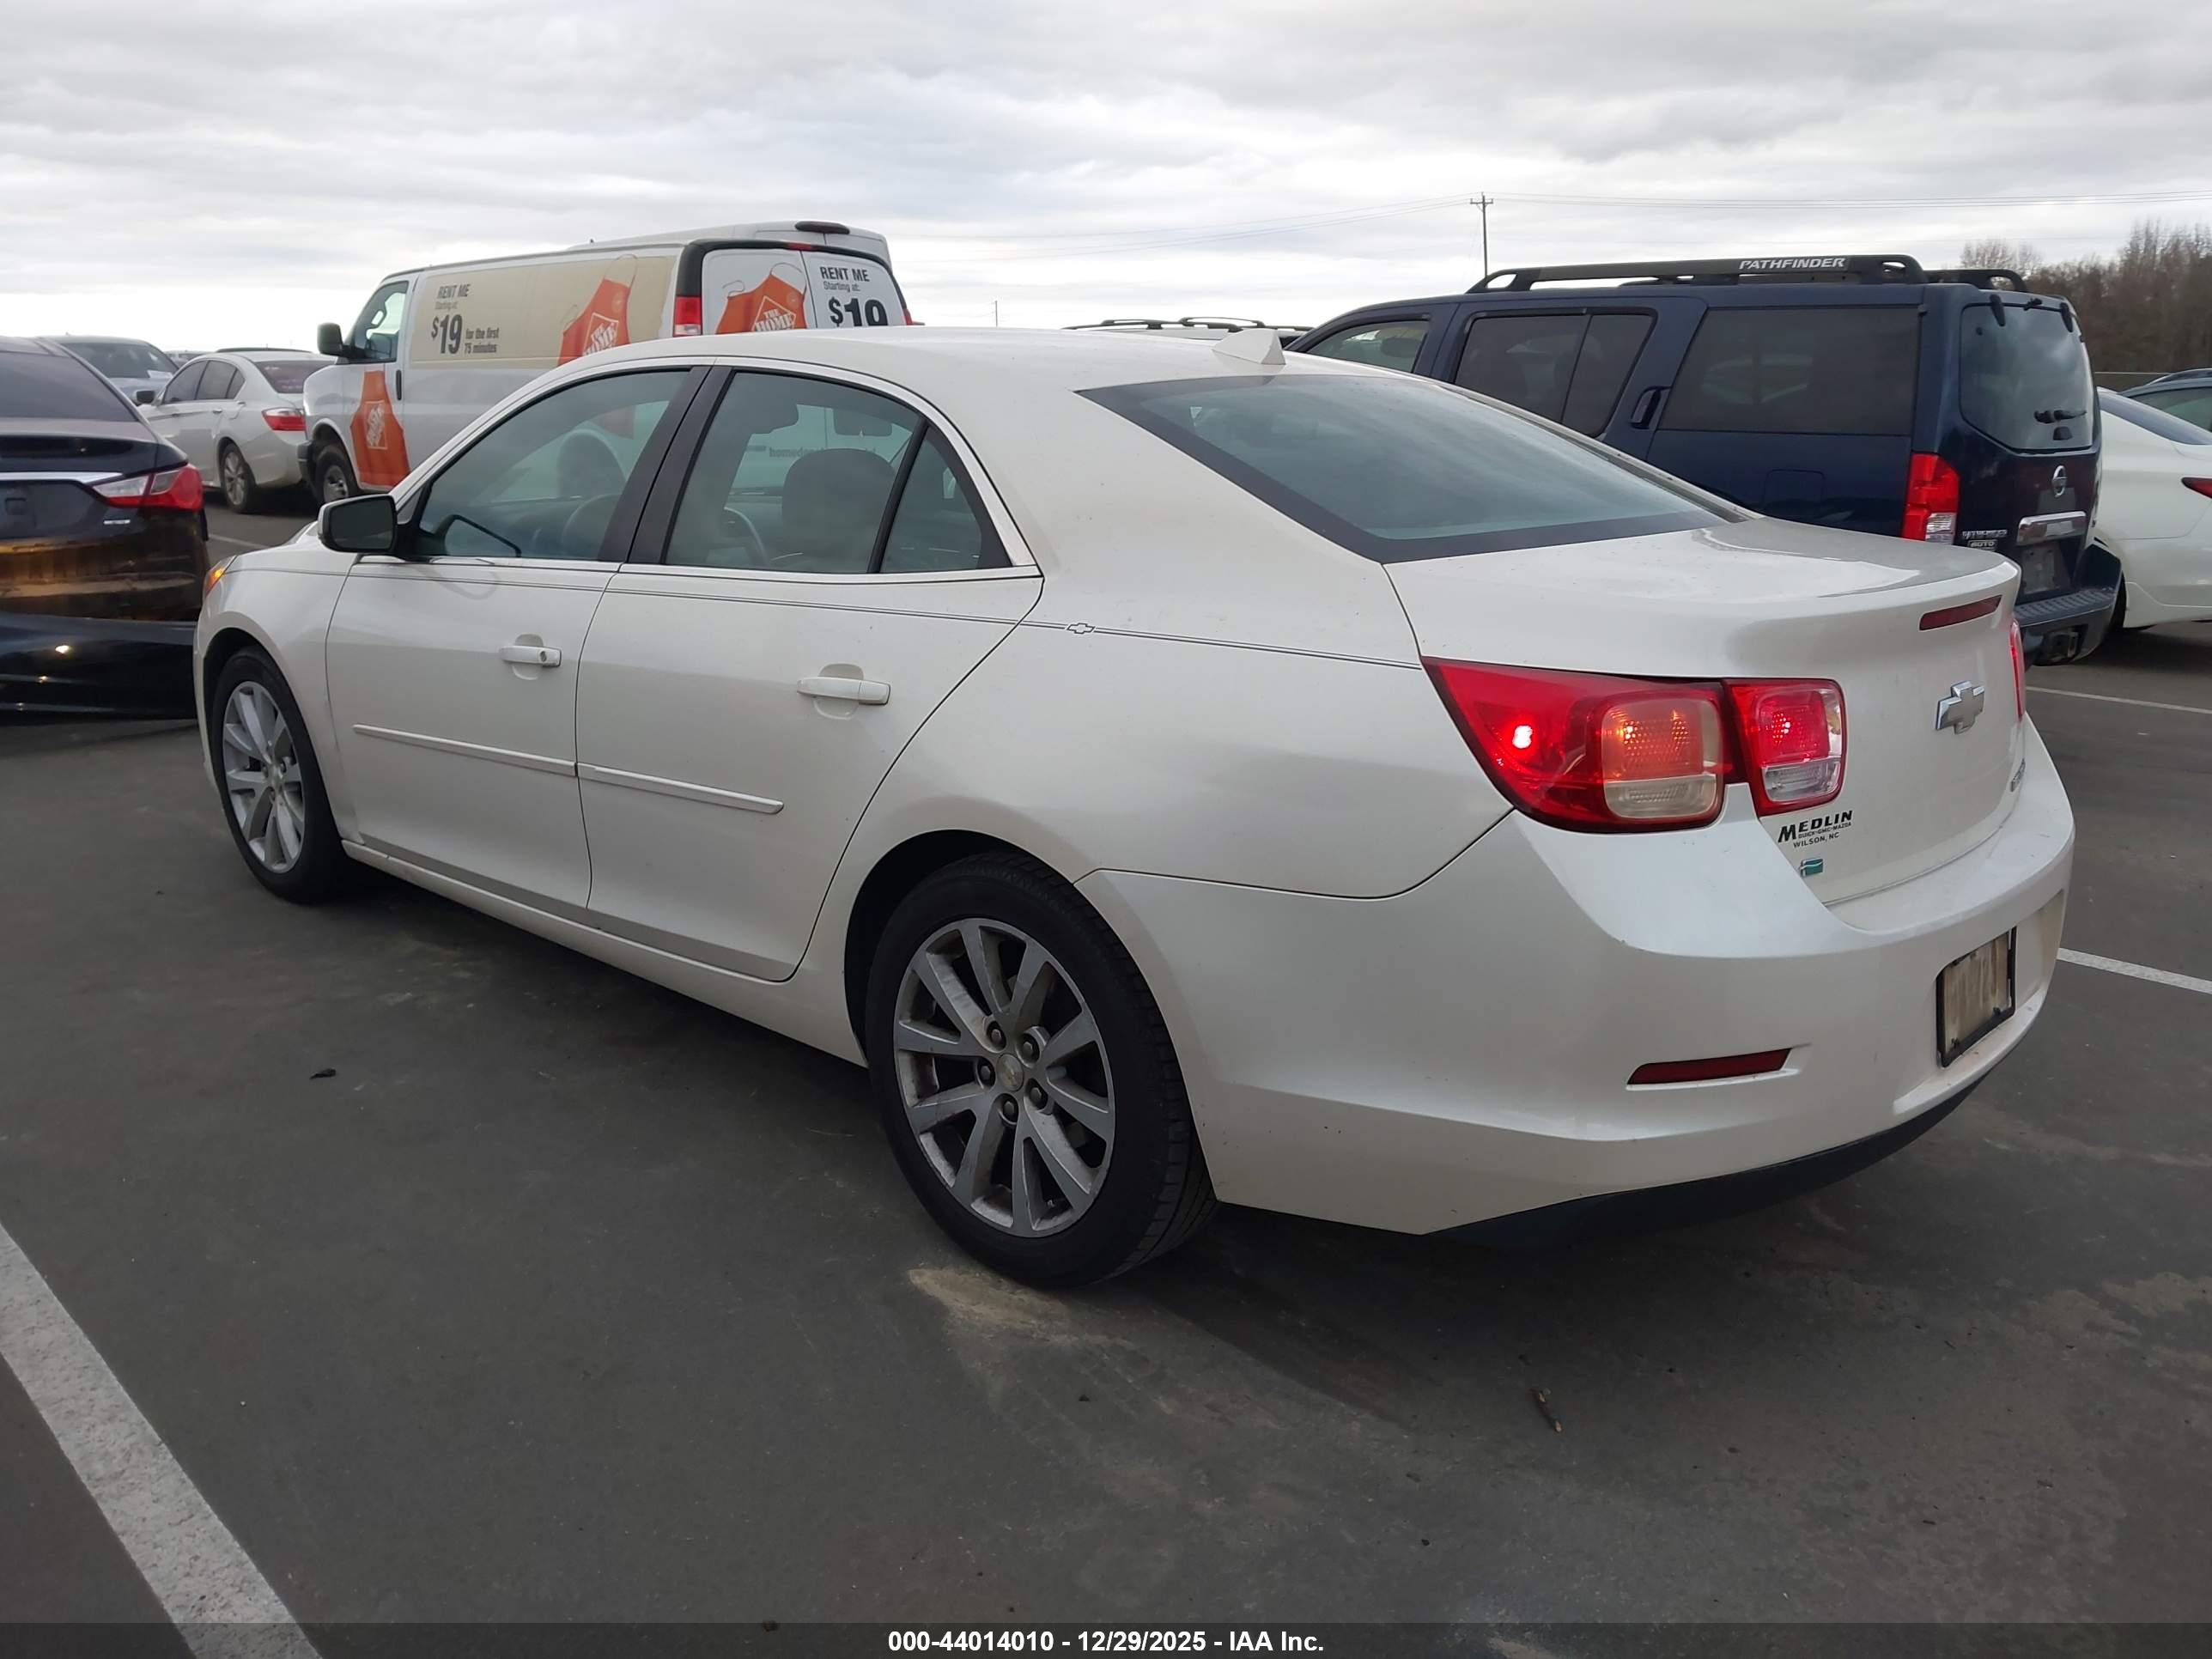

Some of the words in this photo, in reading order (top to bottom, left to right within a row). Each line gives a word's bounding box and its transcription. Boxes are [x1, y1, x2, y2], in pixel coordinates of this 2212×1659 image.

[1739, 258, 1846, 270] PATHFINDER
[820, 266, 848, 281] RENT
[852, 269, 870, 282] ME
[437, 285, 457, 299] RENT
[458, 283, 471, 297] ME
[823, 282, 850, 293] Starting
[431, 314, 463, 355] $19
[475, 328, 485, 340] the
[1778, 810, 1853, 843] MEDLIN
[1793, 835, 1827, 848] WILSON,
[1829, 831, 1840, 840] NC
